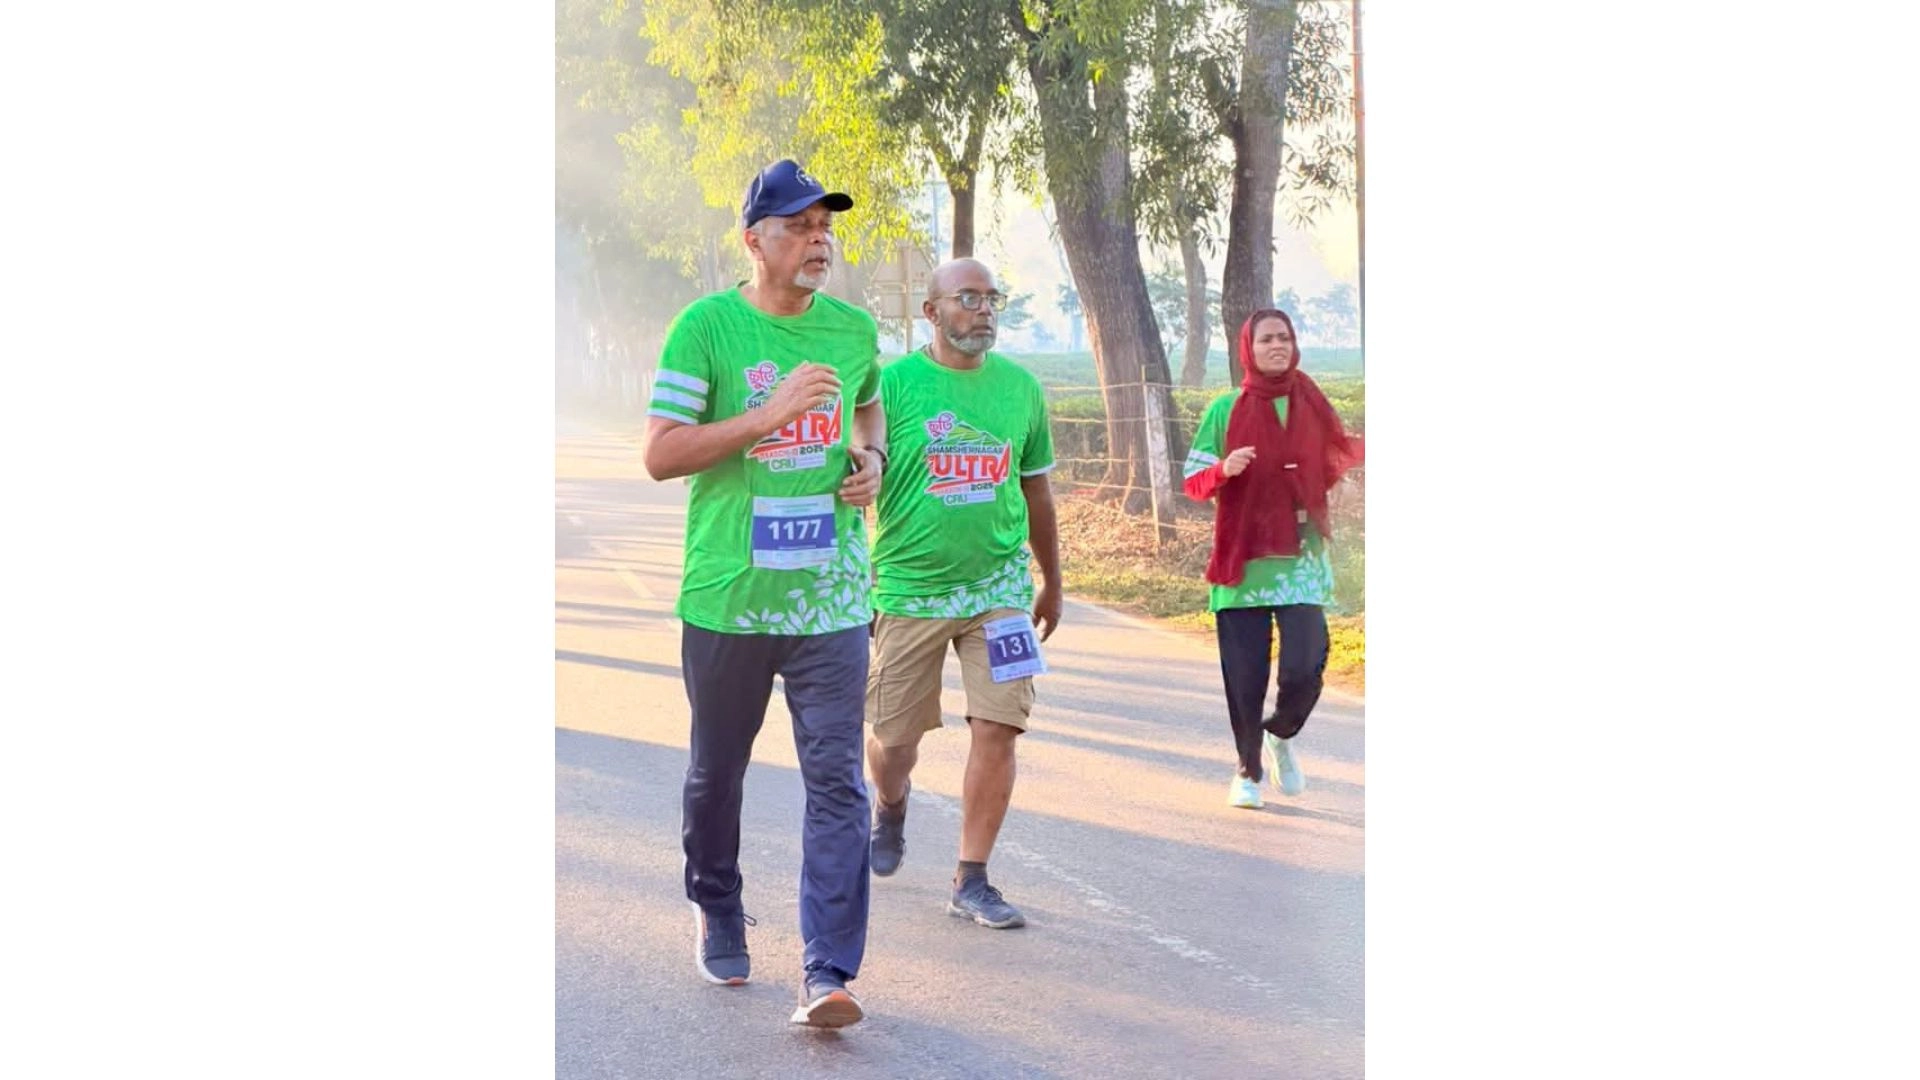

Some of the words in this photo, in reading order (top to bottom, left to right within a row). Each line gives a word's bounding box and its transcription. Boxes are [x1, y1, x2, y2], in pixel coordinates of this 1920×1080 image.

[931, 442, 1010, 484] ULTRA
[767, 519, 822, 541] 1177
[997, 633, 1033, 658] 131
